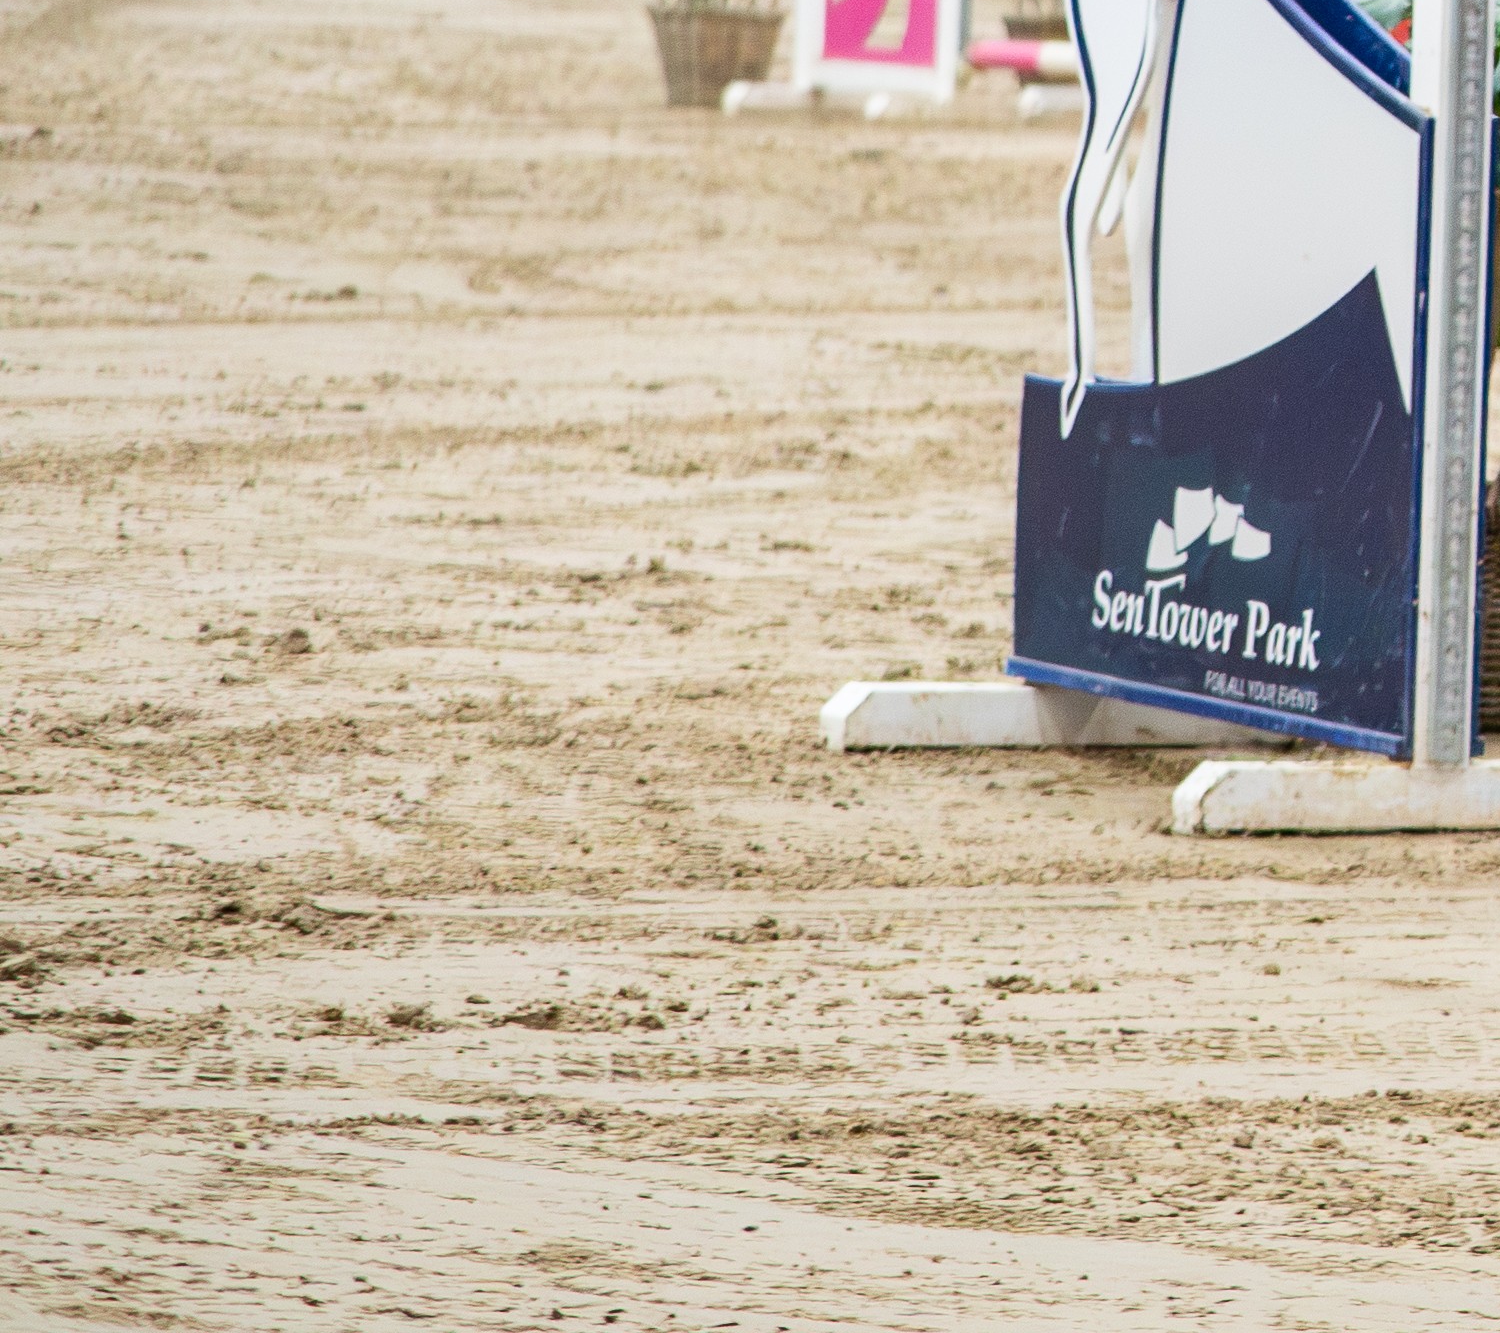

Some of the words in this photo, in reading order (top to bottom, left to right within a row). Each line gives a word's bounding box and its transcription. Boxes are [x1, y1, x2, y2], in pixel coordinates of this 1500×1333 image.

[1091, 567, 1240, 656] SenTower
[1242, 599, 1323, 672] Park
[1204, 669, 1227, 692] FOR
[1227, 674, 1249, 697] ALL
[1247, 678, 1278, 705] YOUR
[1276, 685, 1320, 713] EVENTS
